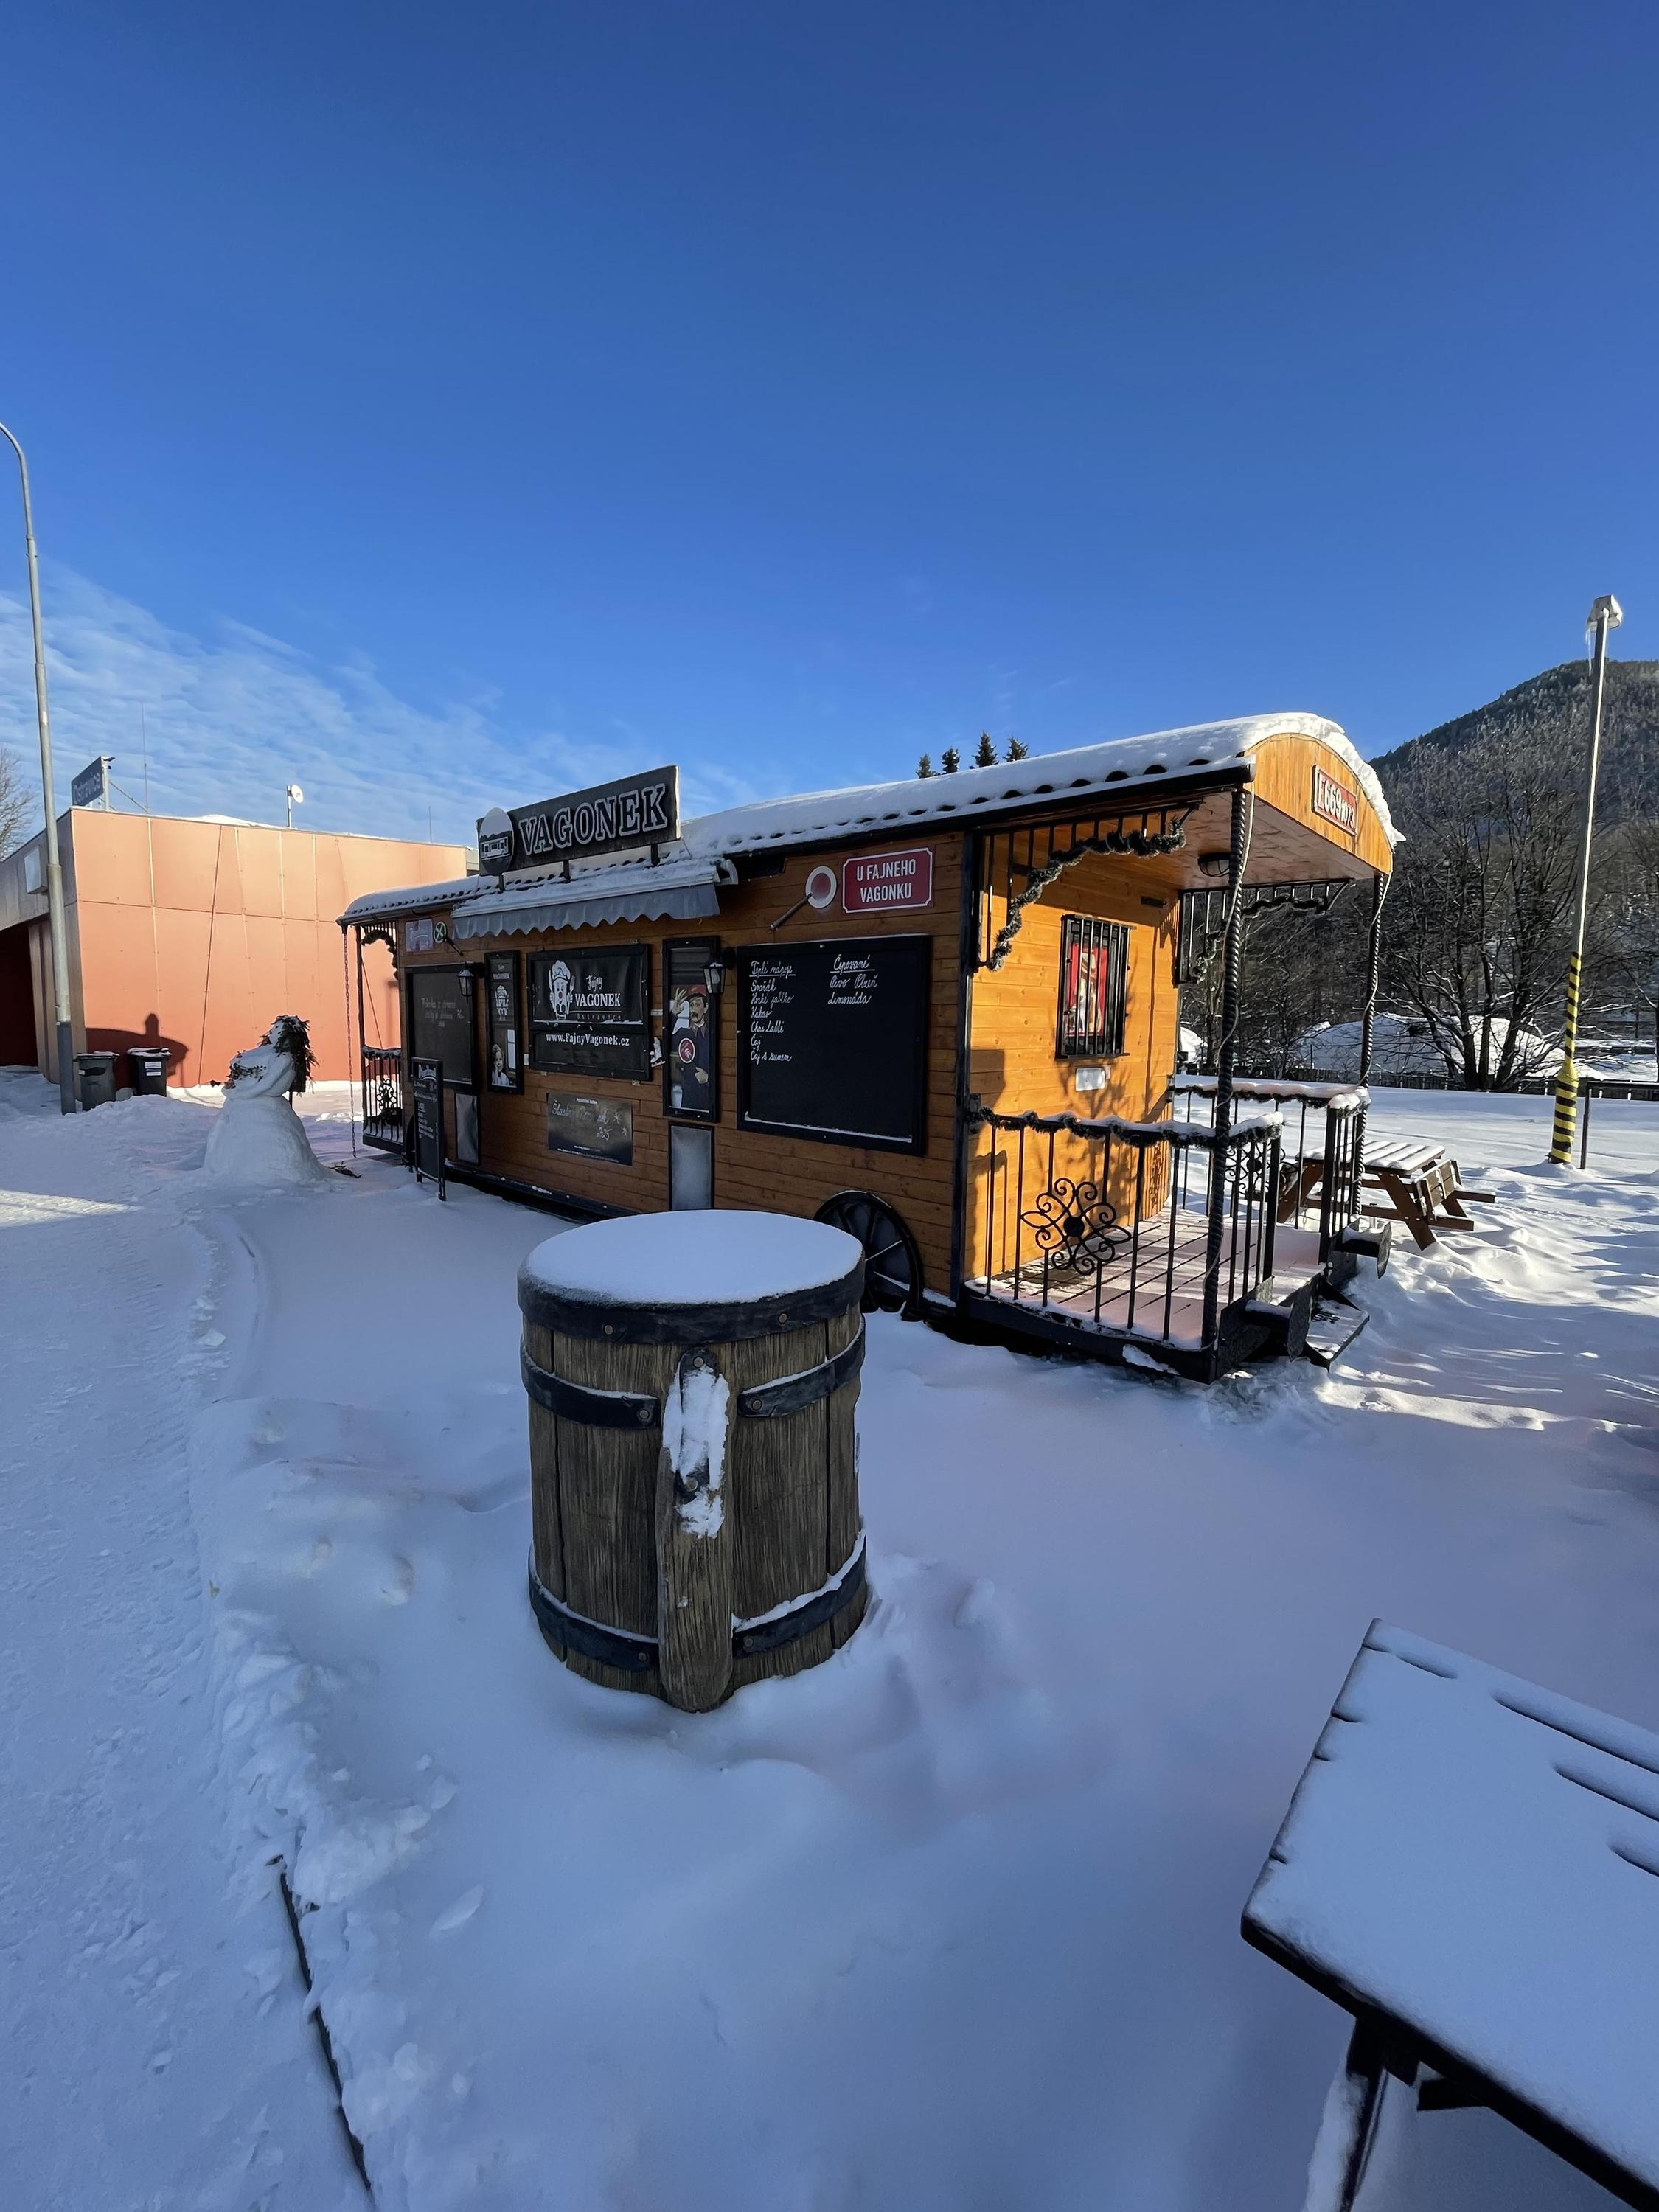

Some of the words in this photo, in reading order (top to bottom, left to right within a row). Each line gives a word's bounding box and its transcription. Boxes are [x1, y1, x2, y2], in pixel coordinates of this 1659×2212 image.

[519, 783, 668, 855] VAGONEK
[857, 866, 863, 881] U
[866, 859, 916, 880] FAJNEHO
[860, 883, 912, 902] VAGONKU
[575, 992, 621, 1007] VAGONEK
[546, 1032, 630, 1046] www.FajnyVagonek.cz
